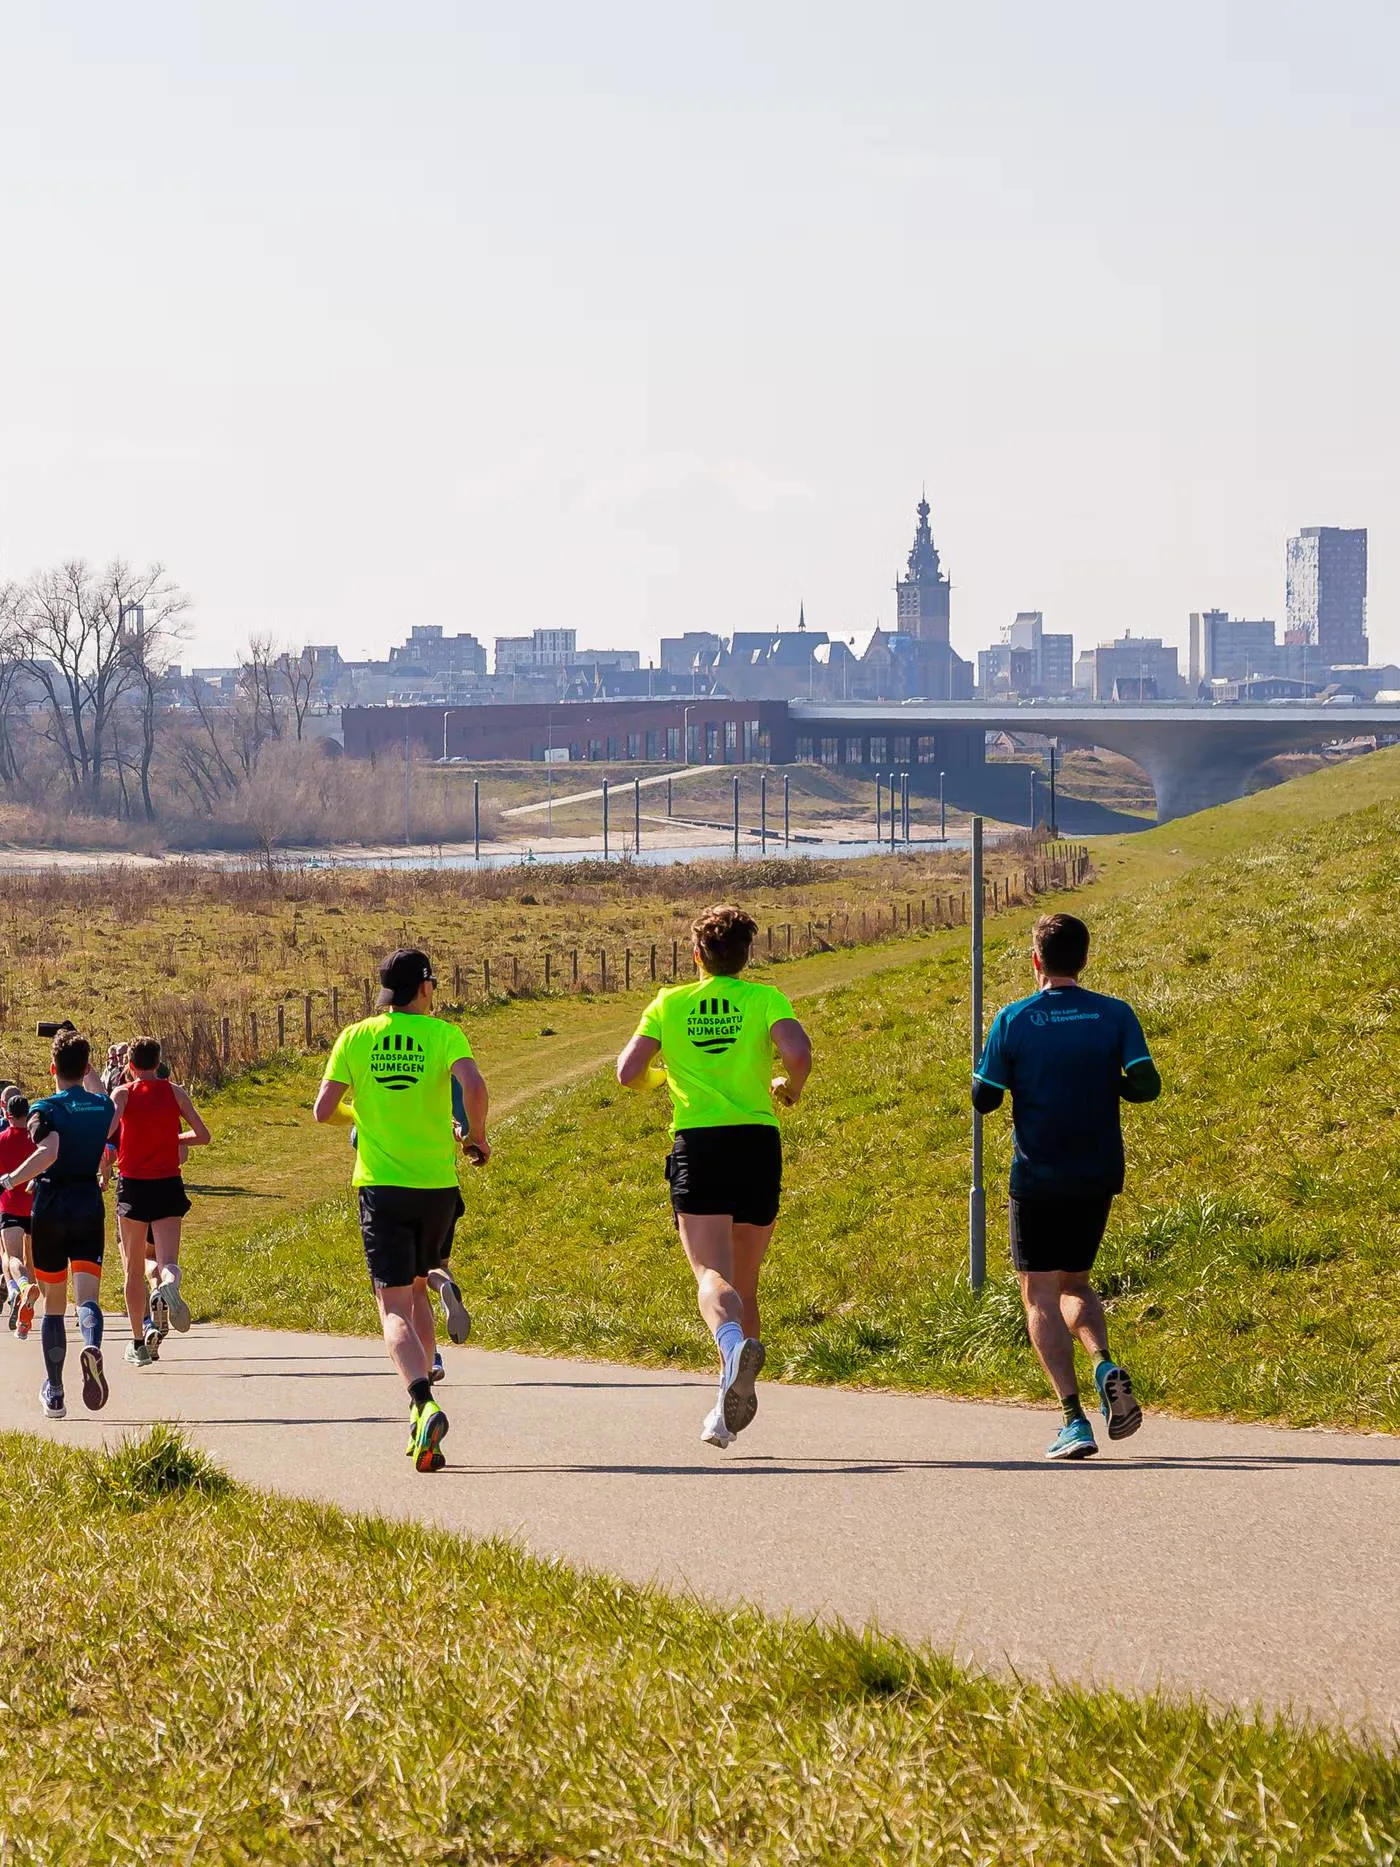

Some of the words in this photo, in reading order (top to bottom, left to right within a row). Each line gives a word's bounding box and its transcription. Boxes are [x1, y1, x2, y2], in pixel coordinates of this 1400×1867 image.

[687, 1015, 743, 1026] STADSPARTIJ
[687, 1024, 743, 1037] NIJMEGEN
[370, 1053, 426, 1063] STADSPARTIJ
[370, 1062, 425, 1073] NIJMEGEN
